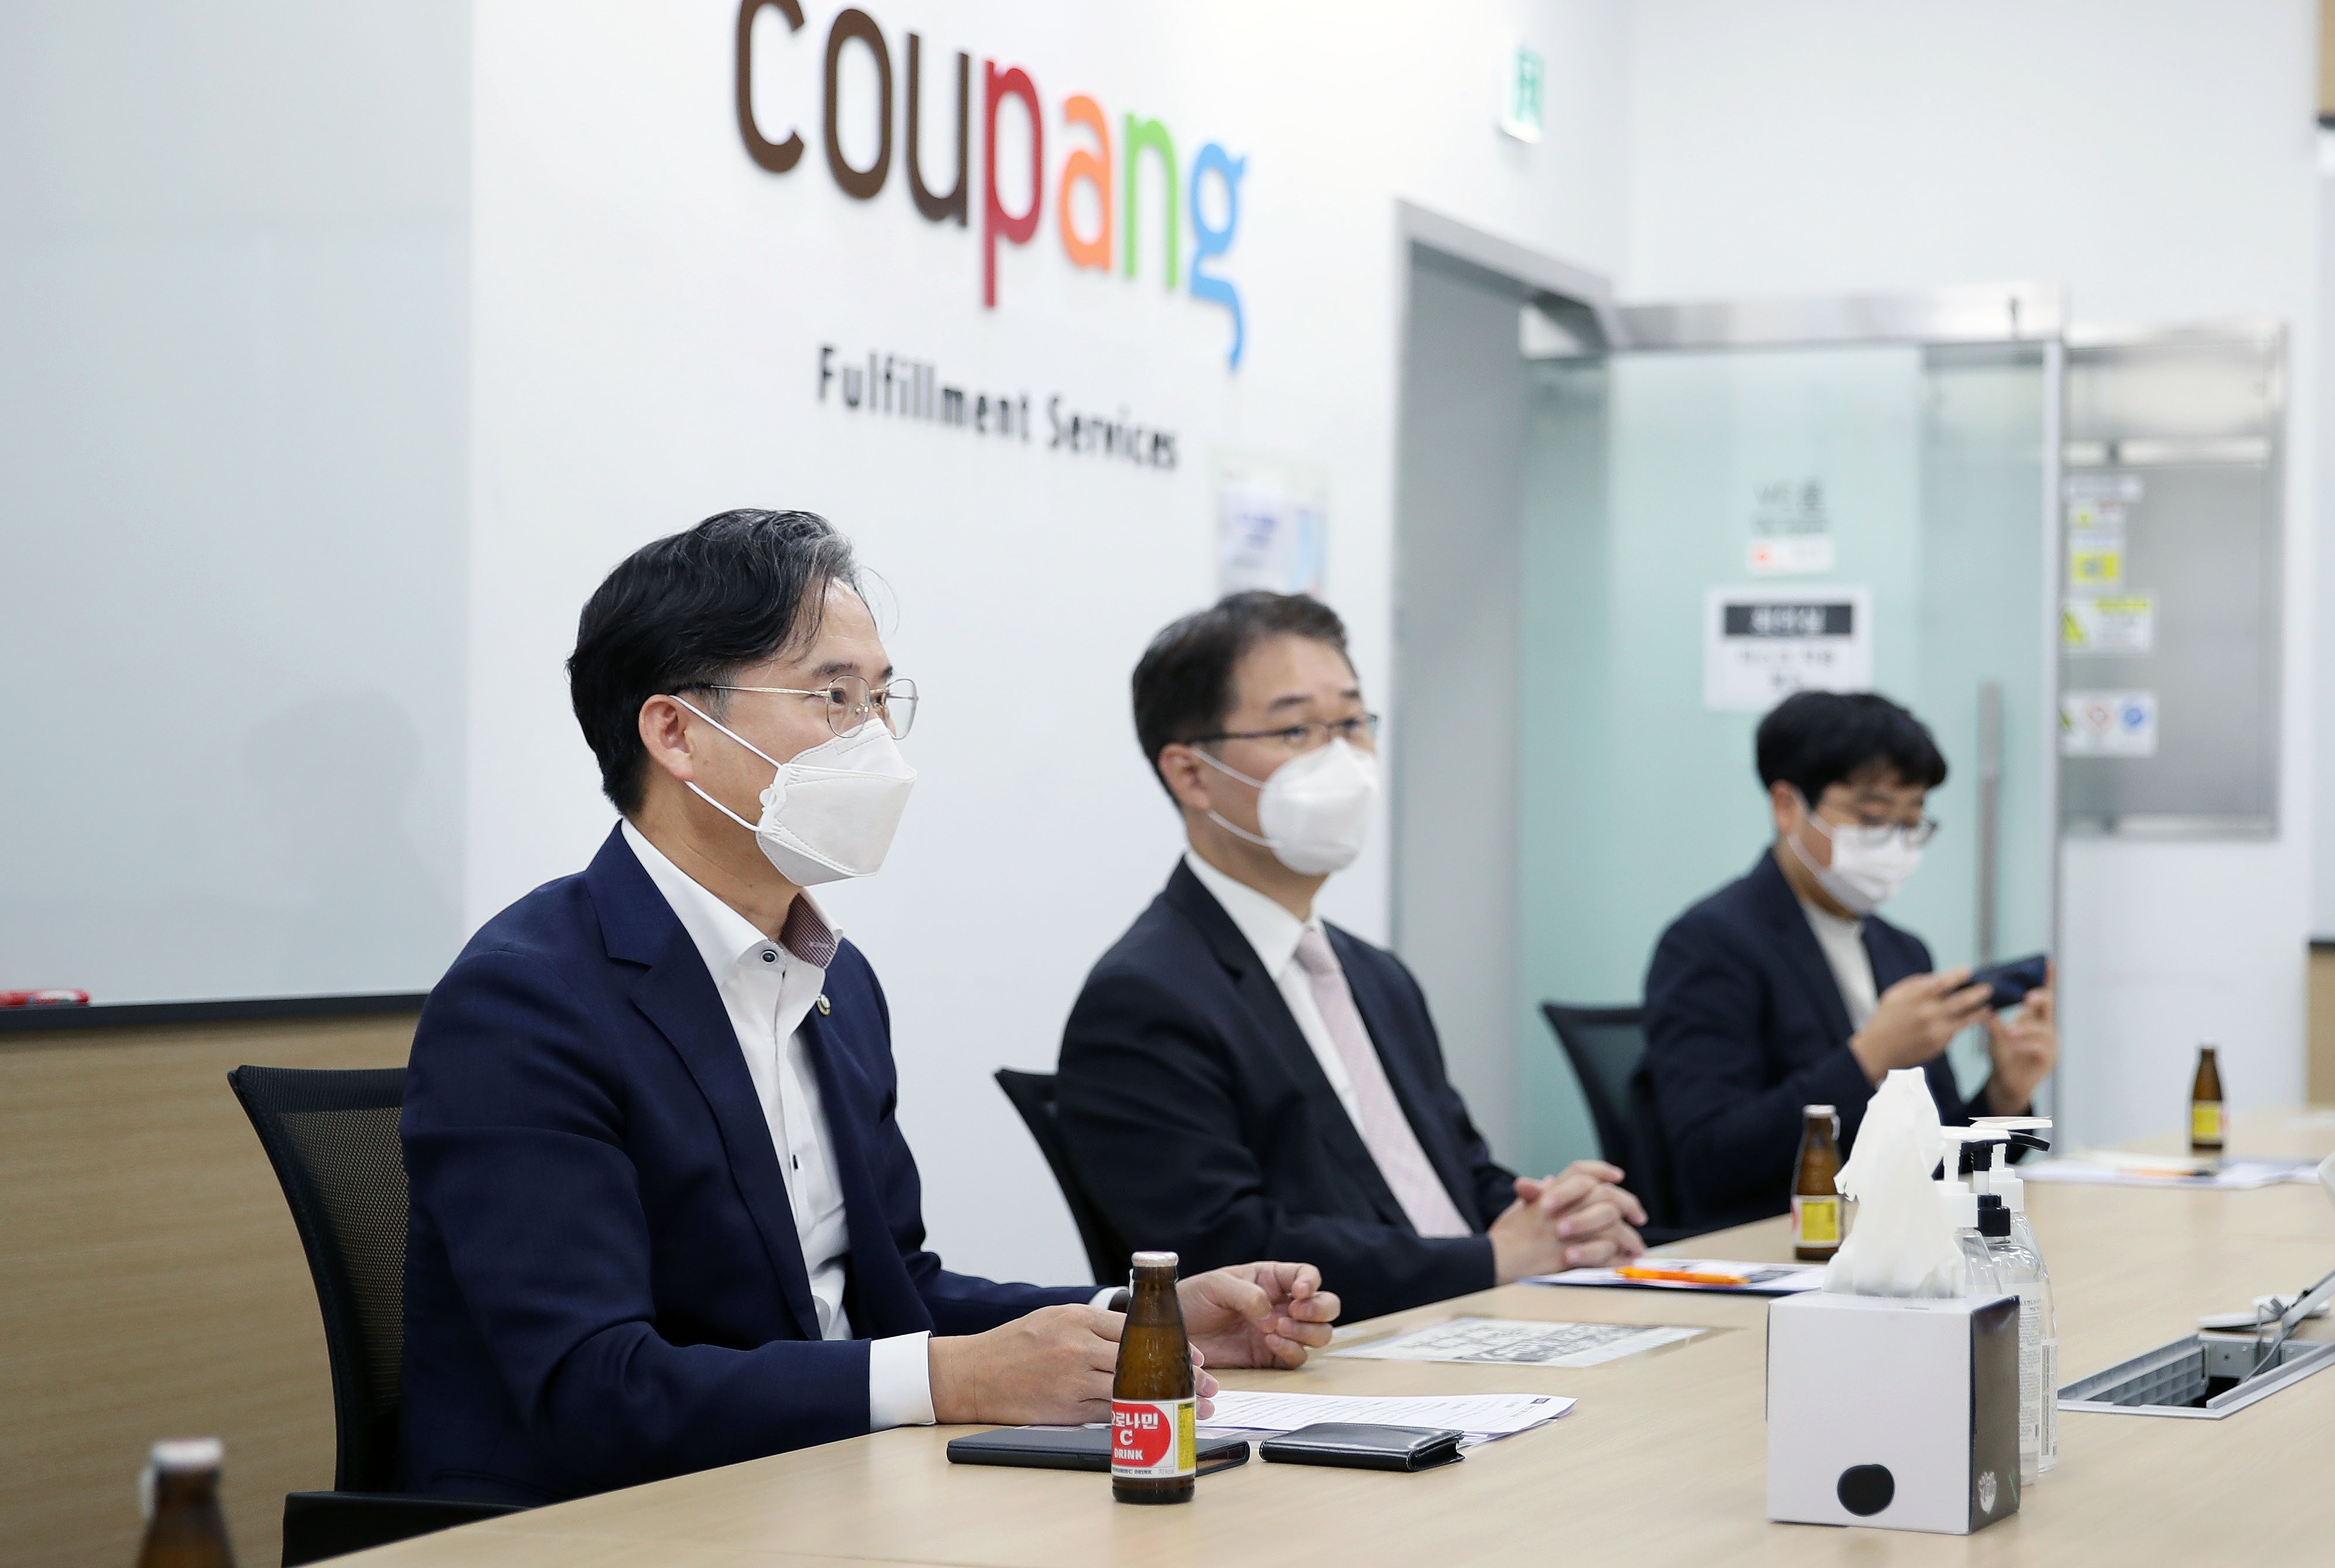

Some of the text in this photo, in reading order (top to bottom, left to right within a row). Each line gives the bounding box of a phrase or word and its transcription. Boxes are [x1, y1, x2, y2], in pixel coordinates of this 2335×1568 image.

[735, 0, 1248, 374] coupang
[817, 345, 1179, 471] Fulfillment Services
[1114, 1447, 1144, 1461] DRINK
[1119, 1430, 1134, 1446] C
